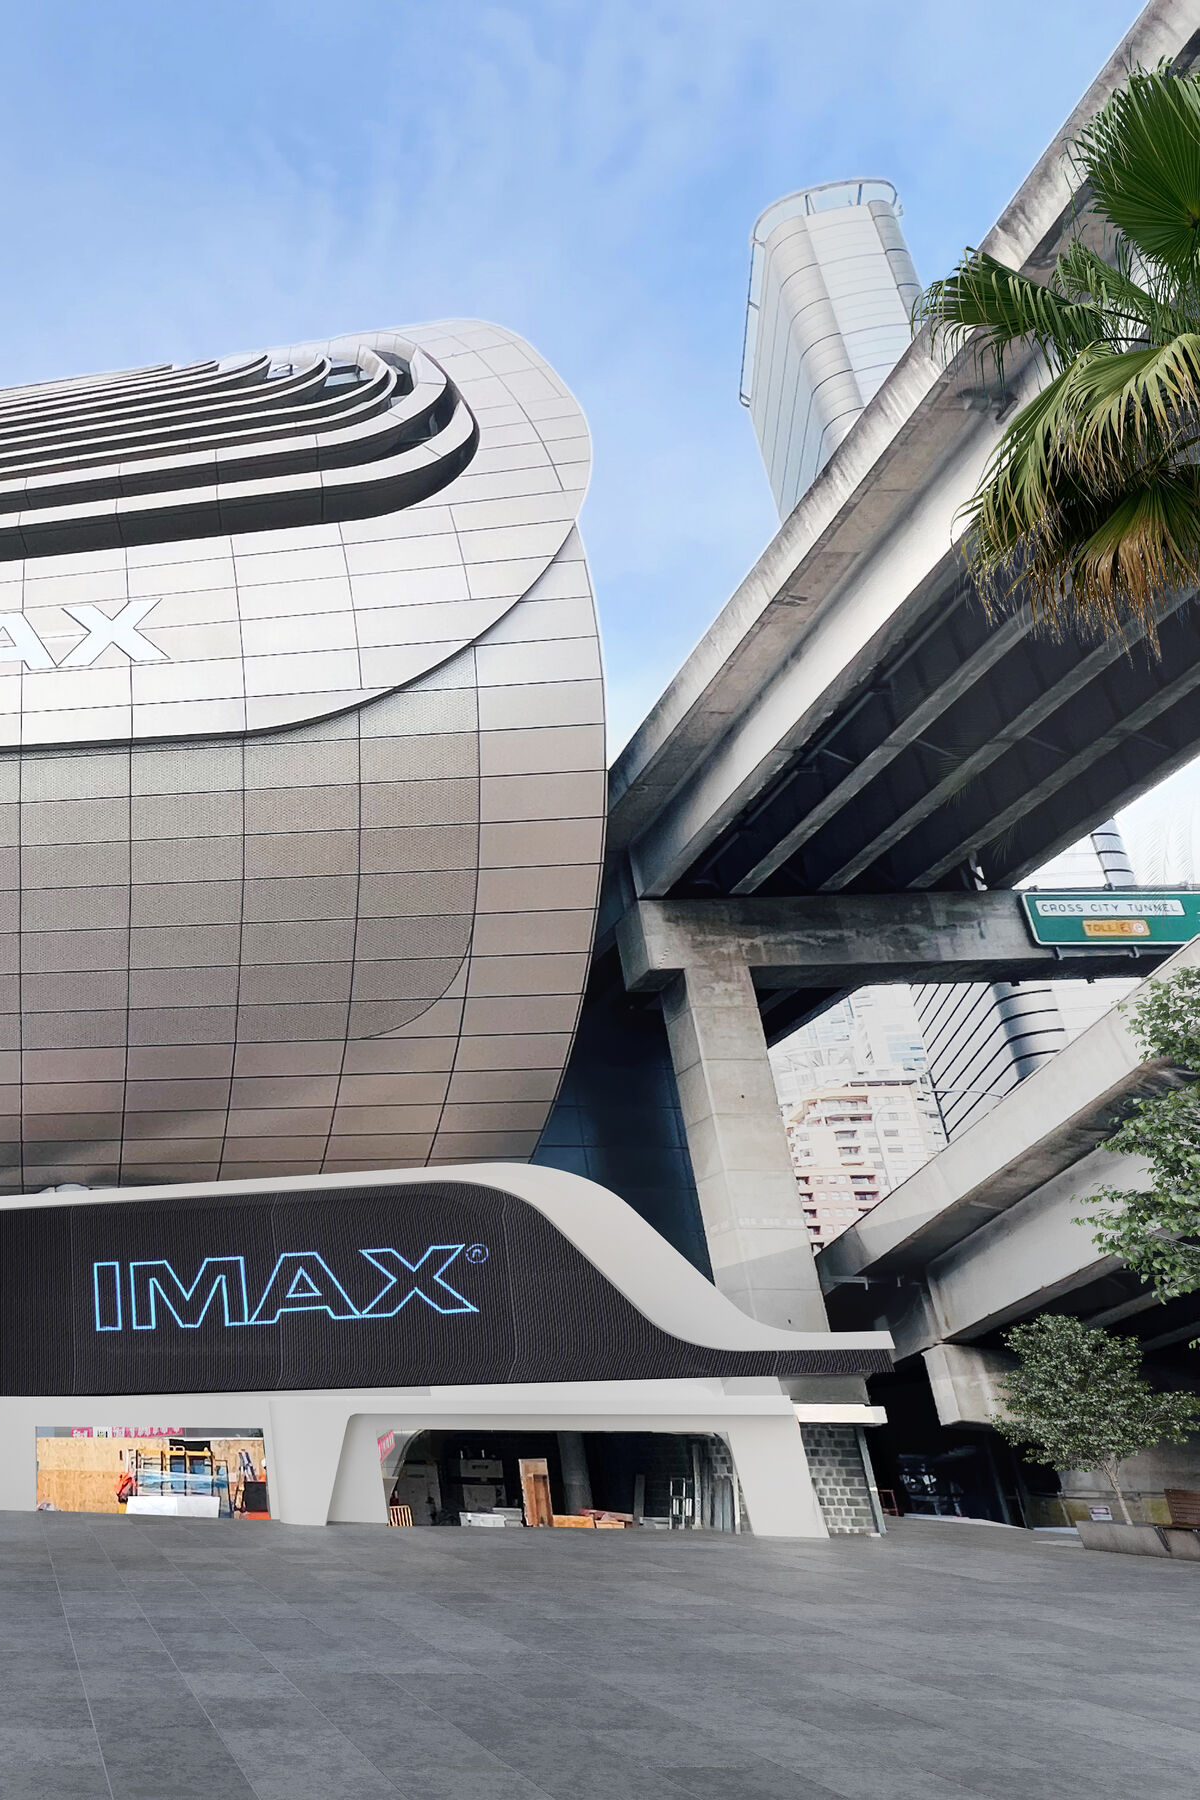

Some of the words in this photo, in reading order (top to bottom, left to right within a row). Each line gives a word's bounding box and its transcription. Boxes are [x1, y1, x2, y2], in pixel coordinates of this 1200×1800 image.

[1041, 903, 1084, 912] CROSS
[1090, 903, 1119, 912] CITY
[1127, 903, 1179, 912] TUNNEL
[1085, 924, 1117, 932] TOLL
